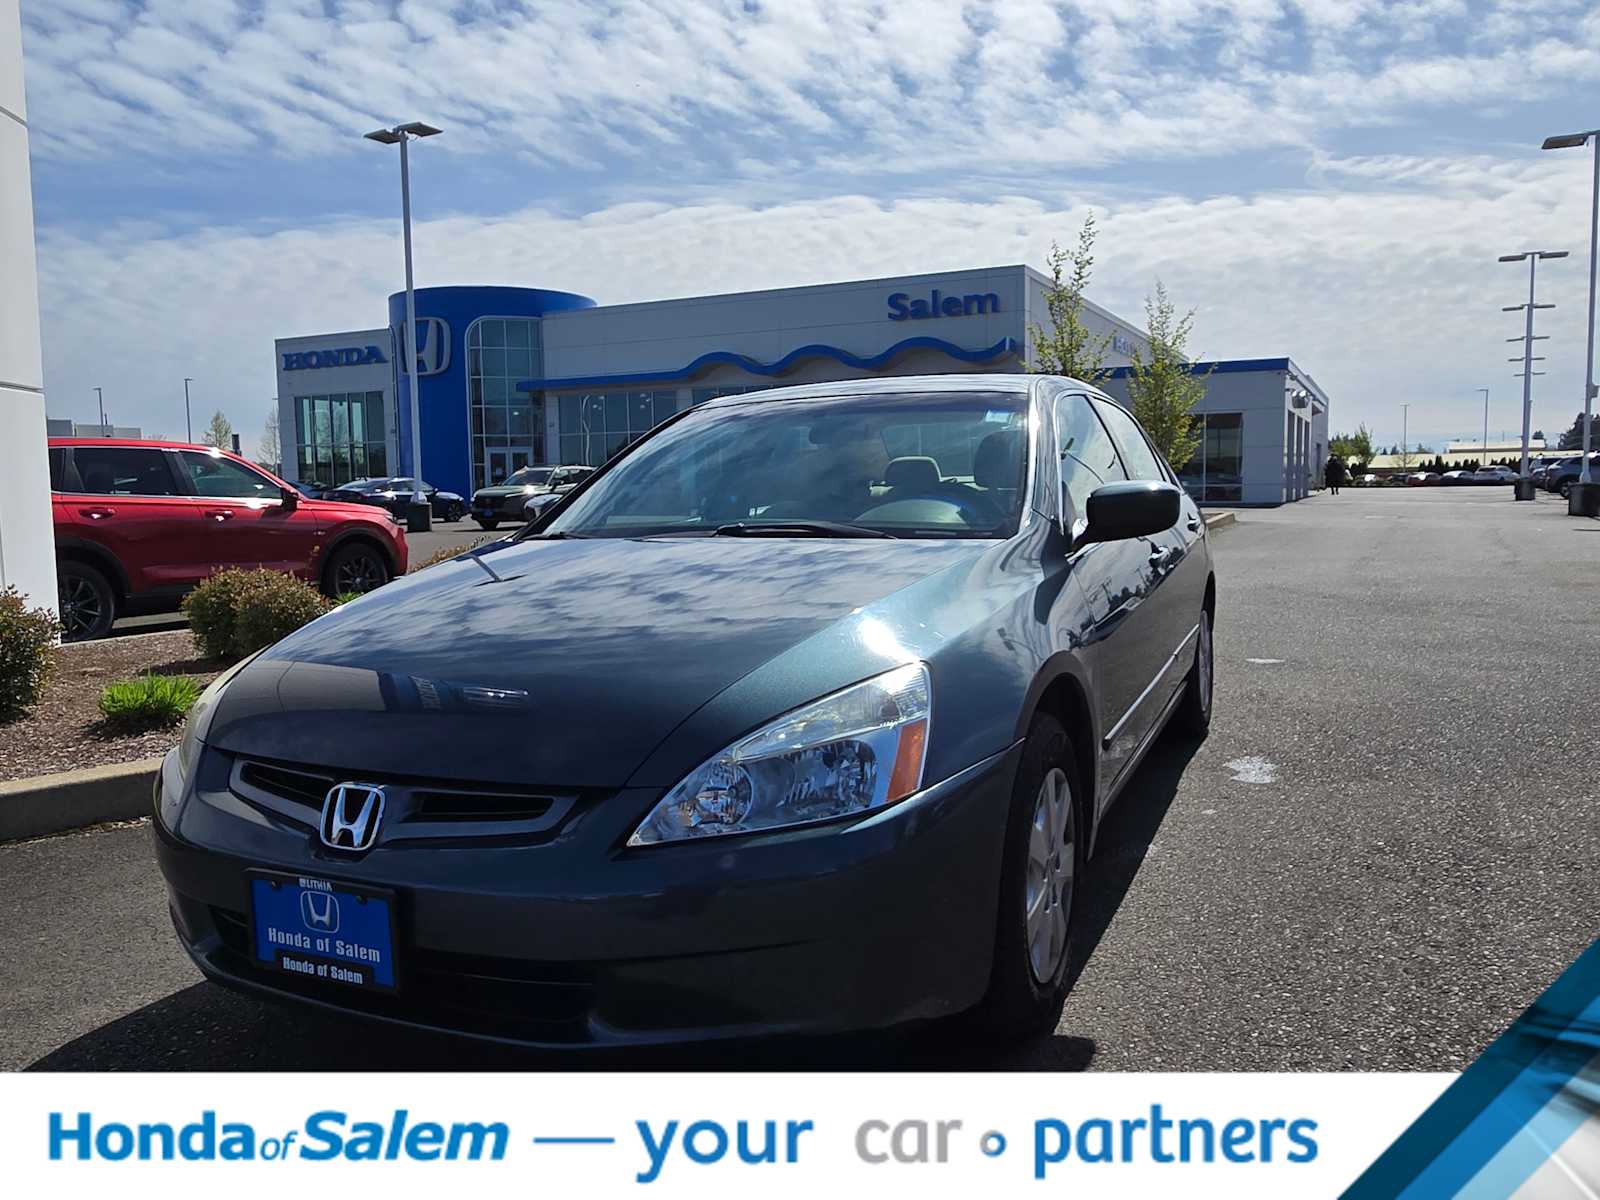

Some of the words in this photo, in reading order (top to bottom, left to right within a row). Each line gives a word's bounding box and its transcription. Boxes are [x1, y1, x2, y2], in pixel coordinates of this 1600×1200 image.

[887, 289, 999, 321] Salem
[282, 346, 388, 371] HONDA
[268, 928, 311, 949] Honda
[317, 938, 330, 952] of
[336, 940, 380, 963] Salem
[283, 956, 315, 975] Honda
[317, 963, 329, 977] of
[331, 966, 363, 984] Salem
